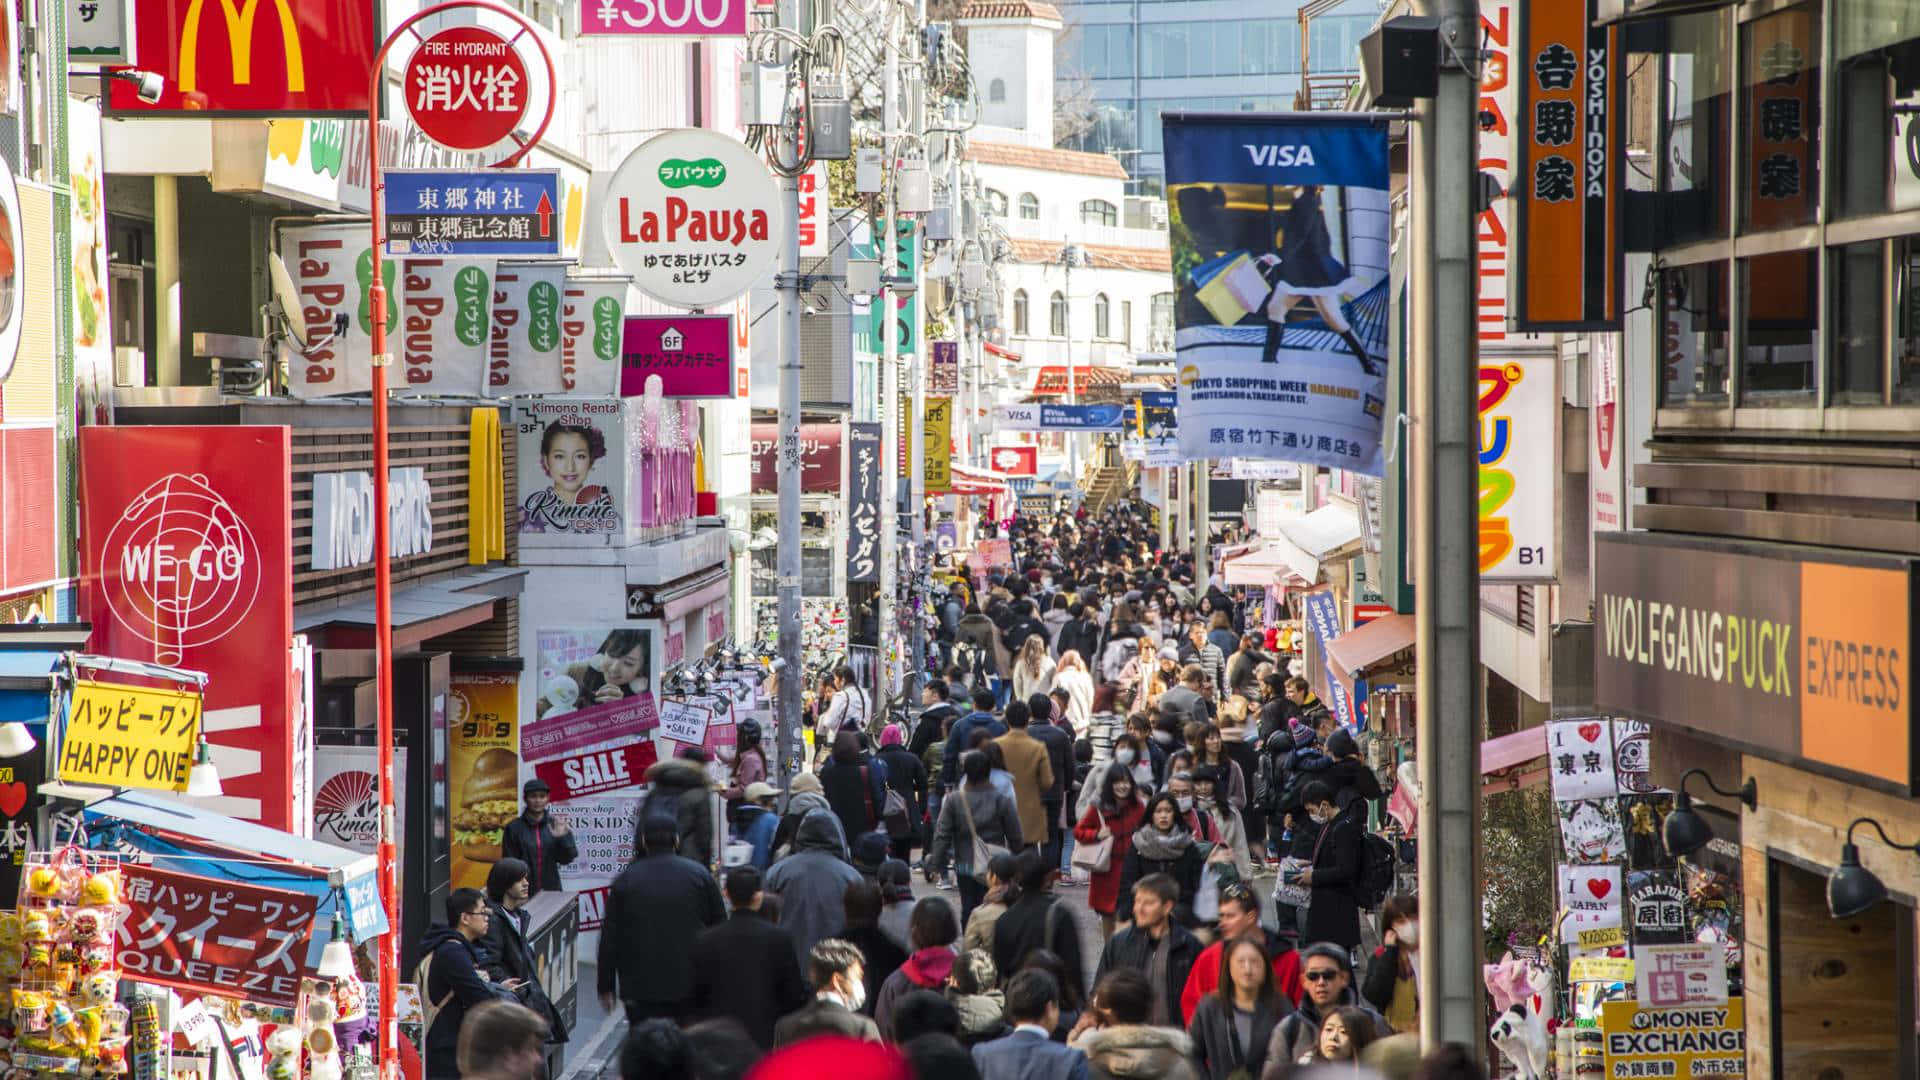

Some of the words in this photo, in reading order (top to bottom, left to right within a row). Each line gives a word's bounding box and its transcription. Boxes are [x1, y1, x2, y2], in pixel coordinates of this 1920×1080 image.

[425, 42, 450, 56] FIRE
[454, 42, 507, 56] HYDRANT
[416, 64, 519, 111] 消火栓
[1534, 43, 1577, 203] 吉野家
[1243, 144, 1315, 167] VISA
[416, 187, 525, 210] 東郷神社
[416, 216, 530, 239] 東郷記念館
[664, 336, 680, 347] 6F
[1225, 378, 1277, 390] SHOPPING
[1280, 381, 1308, 393] WEEK
[532, 403, 578, 414] Kimono
[582, 403, 620, 414] Rental
[1008, 411, 1032, 420] VISA
[520, 424, 537, 433] 3F
[560, 415, 591, 428] Shop
[1210, 427, 1362, 458] 原宿竹下通り商店会
[525, 487, 616, 530] Kimono
[568, 519, 615, 529] TOKYO
[1519, 548, 1544, 565] B1
[1808, 636, 1900, 712] EXPRESS
[74, 697, 195, 738] ハッピーワン
[64, 740, 139, 778] HAPPY
[144, 748, 189, 783] ONE
[563, 750, 631, 791] SALE
[1559, 752, 1602, 776] 東京
[1567, 878, 1576, 894] I
[1572, 901, 1608, 911] JAPAN
[1638, 904, 1682, 925] 原宿
[117, 951, 297, 997] QUEEZE
[1651, 1011, 1728, 1028] MONEY
[1610, 1034, 1743, 1054] EXCHANG
